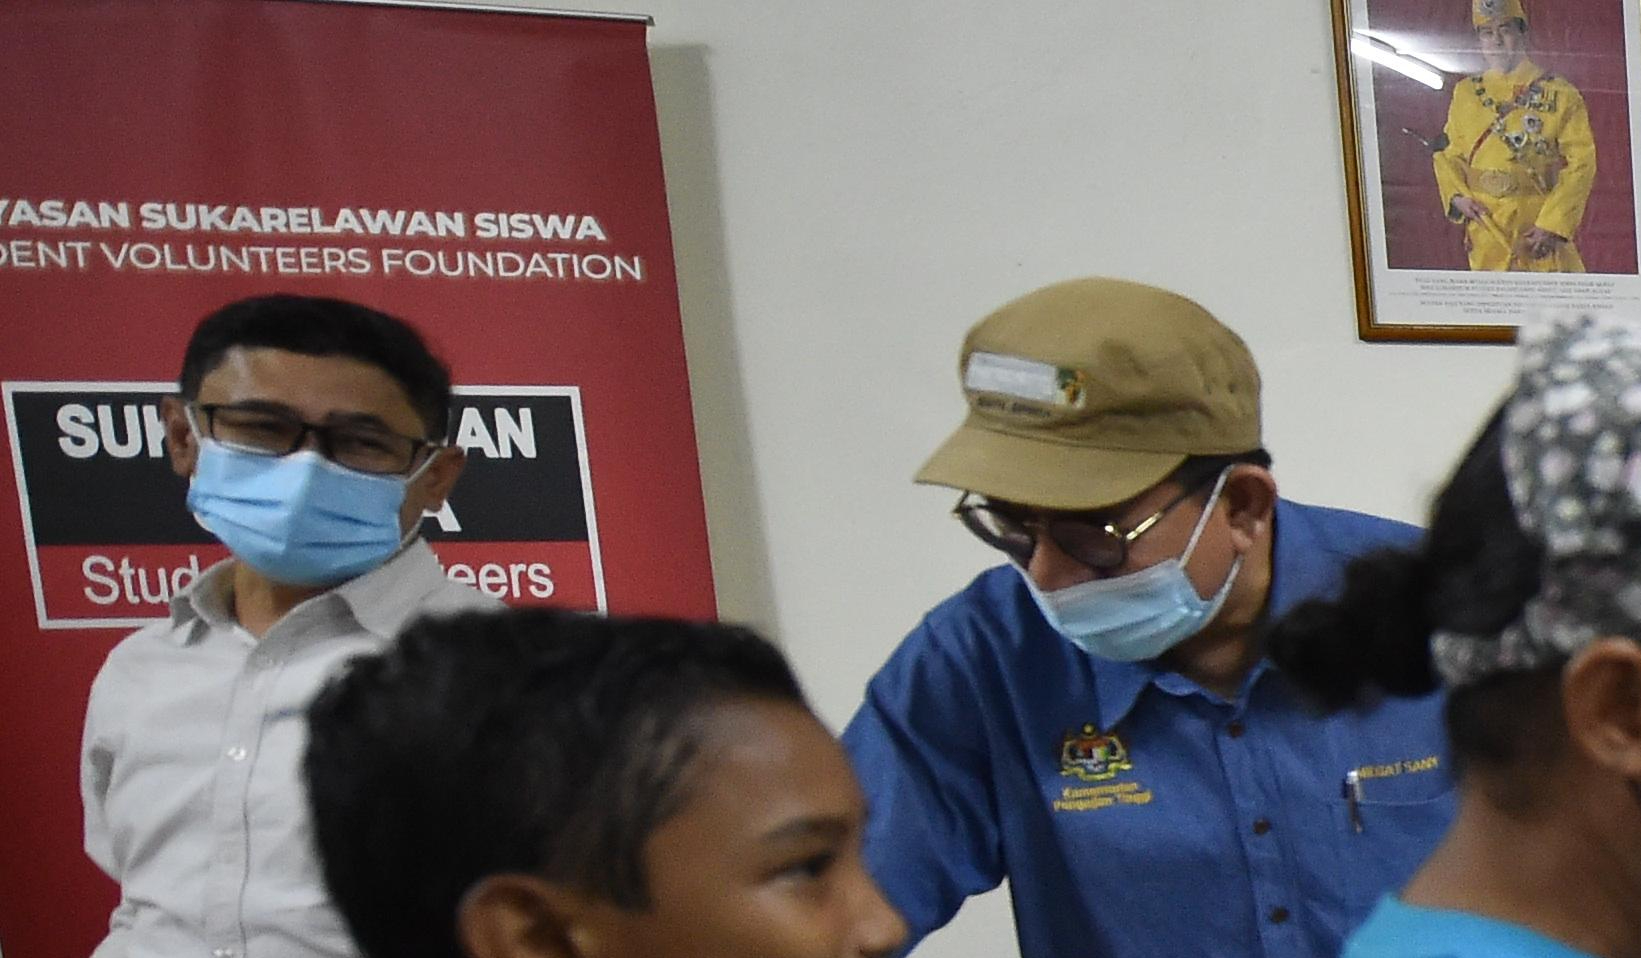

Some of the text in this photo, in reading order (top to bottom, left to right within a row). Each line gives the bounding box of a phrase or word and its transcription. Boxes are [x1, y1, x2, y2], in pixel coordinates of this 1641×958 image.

[140, 202, 465, 237] SUKARELAWAN
[474, 212, 606, 240] SISWA
[100, 243, 371, 274] VOLUNTEERS
[381, 249, 642, 281] FOUNDATION
